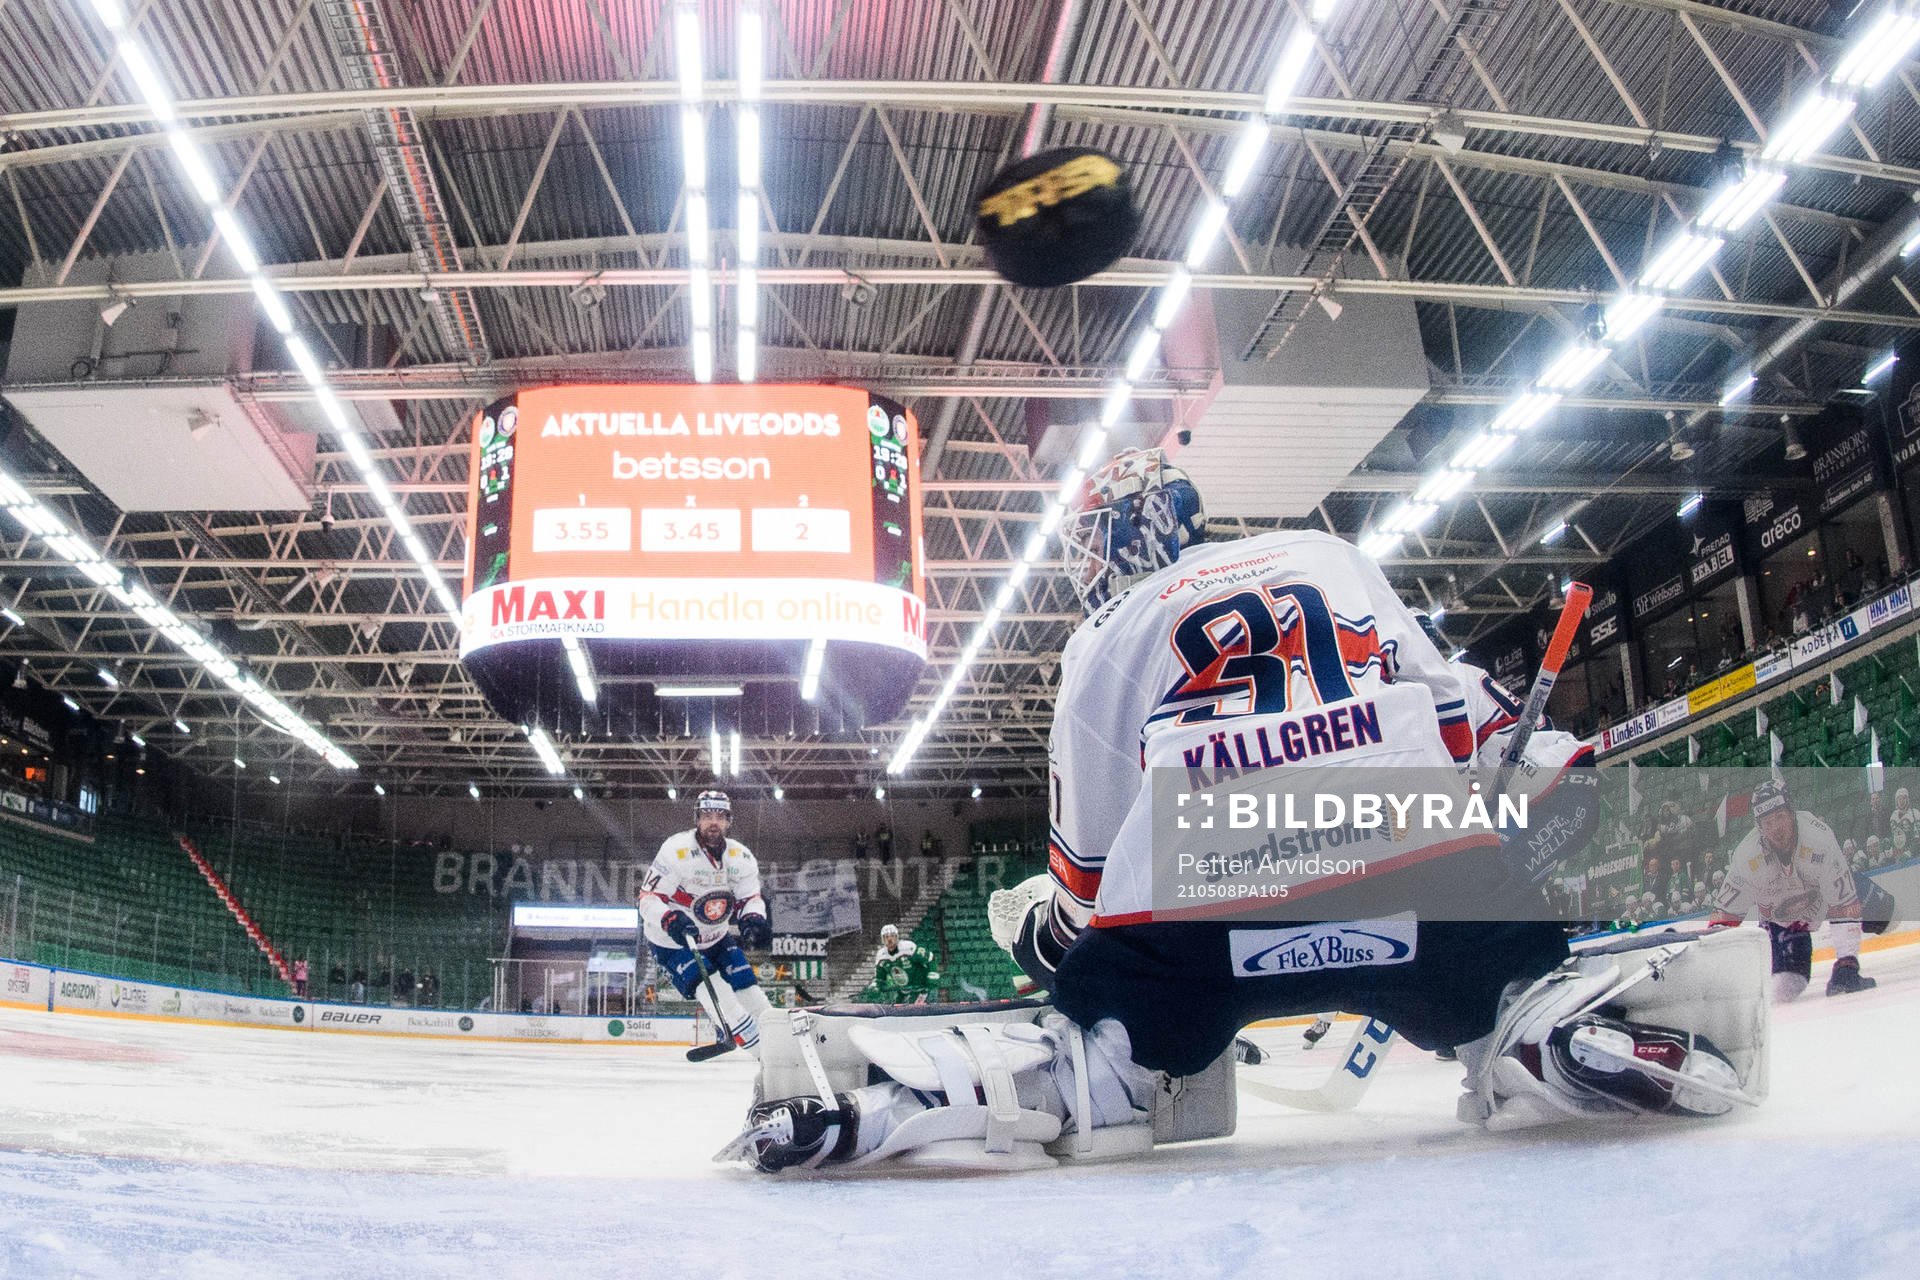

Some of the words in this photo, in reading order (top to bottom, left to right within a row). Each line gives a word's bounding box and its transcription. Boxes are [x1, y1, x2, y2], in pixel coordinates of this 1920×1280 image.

[541, 412, 690, 437] AKTUELLA
[697, 412, 840, 437] LIVEODDS
[613, 451, 771, 480] betsson
[555, 522, 608, 540] 3.55
[664, 522, 720, 540] 3.45
[796, 523, 809, 540] 2
[1761, 512, 1801, 549] areco
[1196, 550, 1289, 577] Supermarket
[1191, 563, 1279, 592] Borgholm
[491, 586, 605, 627] MAXI
[630, 591, 764, 623] Handla
[777, 592, 883, 624] online
[507, 622, 605, 637] STORMARKNAD
[1590, 615, 1617, 646] SSE
[1843, 621, 1853, 636] IT
[1170, 580, 1359, 728] 81
[1612, 719, 1643, 745] Lindells
[1644, 711, 1657, 731] Bil
[1183, 700, 1384, 793] KÄLLGREN
[643, 870, 661, 892] 14
[1717, 882, 1741, 908] 27
[772, 934, 827, 956] RÖGLE
[1277, 934, 1374, 972] FleXBuss
[8, 979, 30, 994] SYSTEM
[60, 982, 97, 1000] AGRIZON
[321, 1011, 382, 1025] BAUER
[627, 1020, 652, 1031] Solid
[1637, 1044, 1670, 1055] CCM
